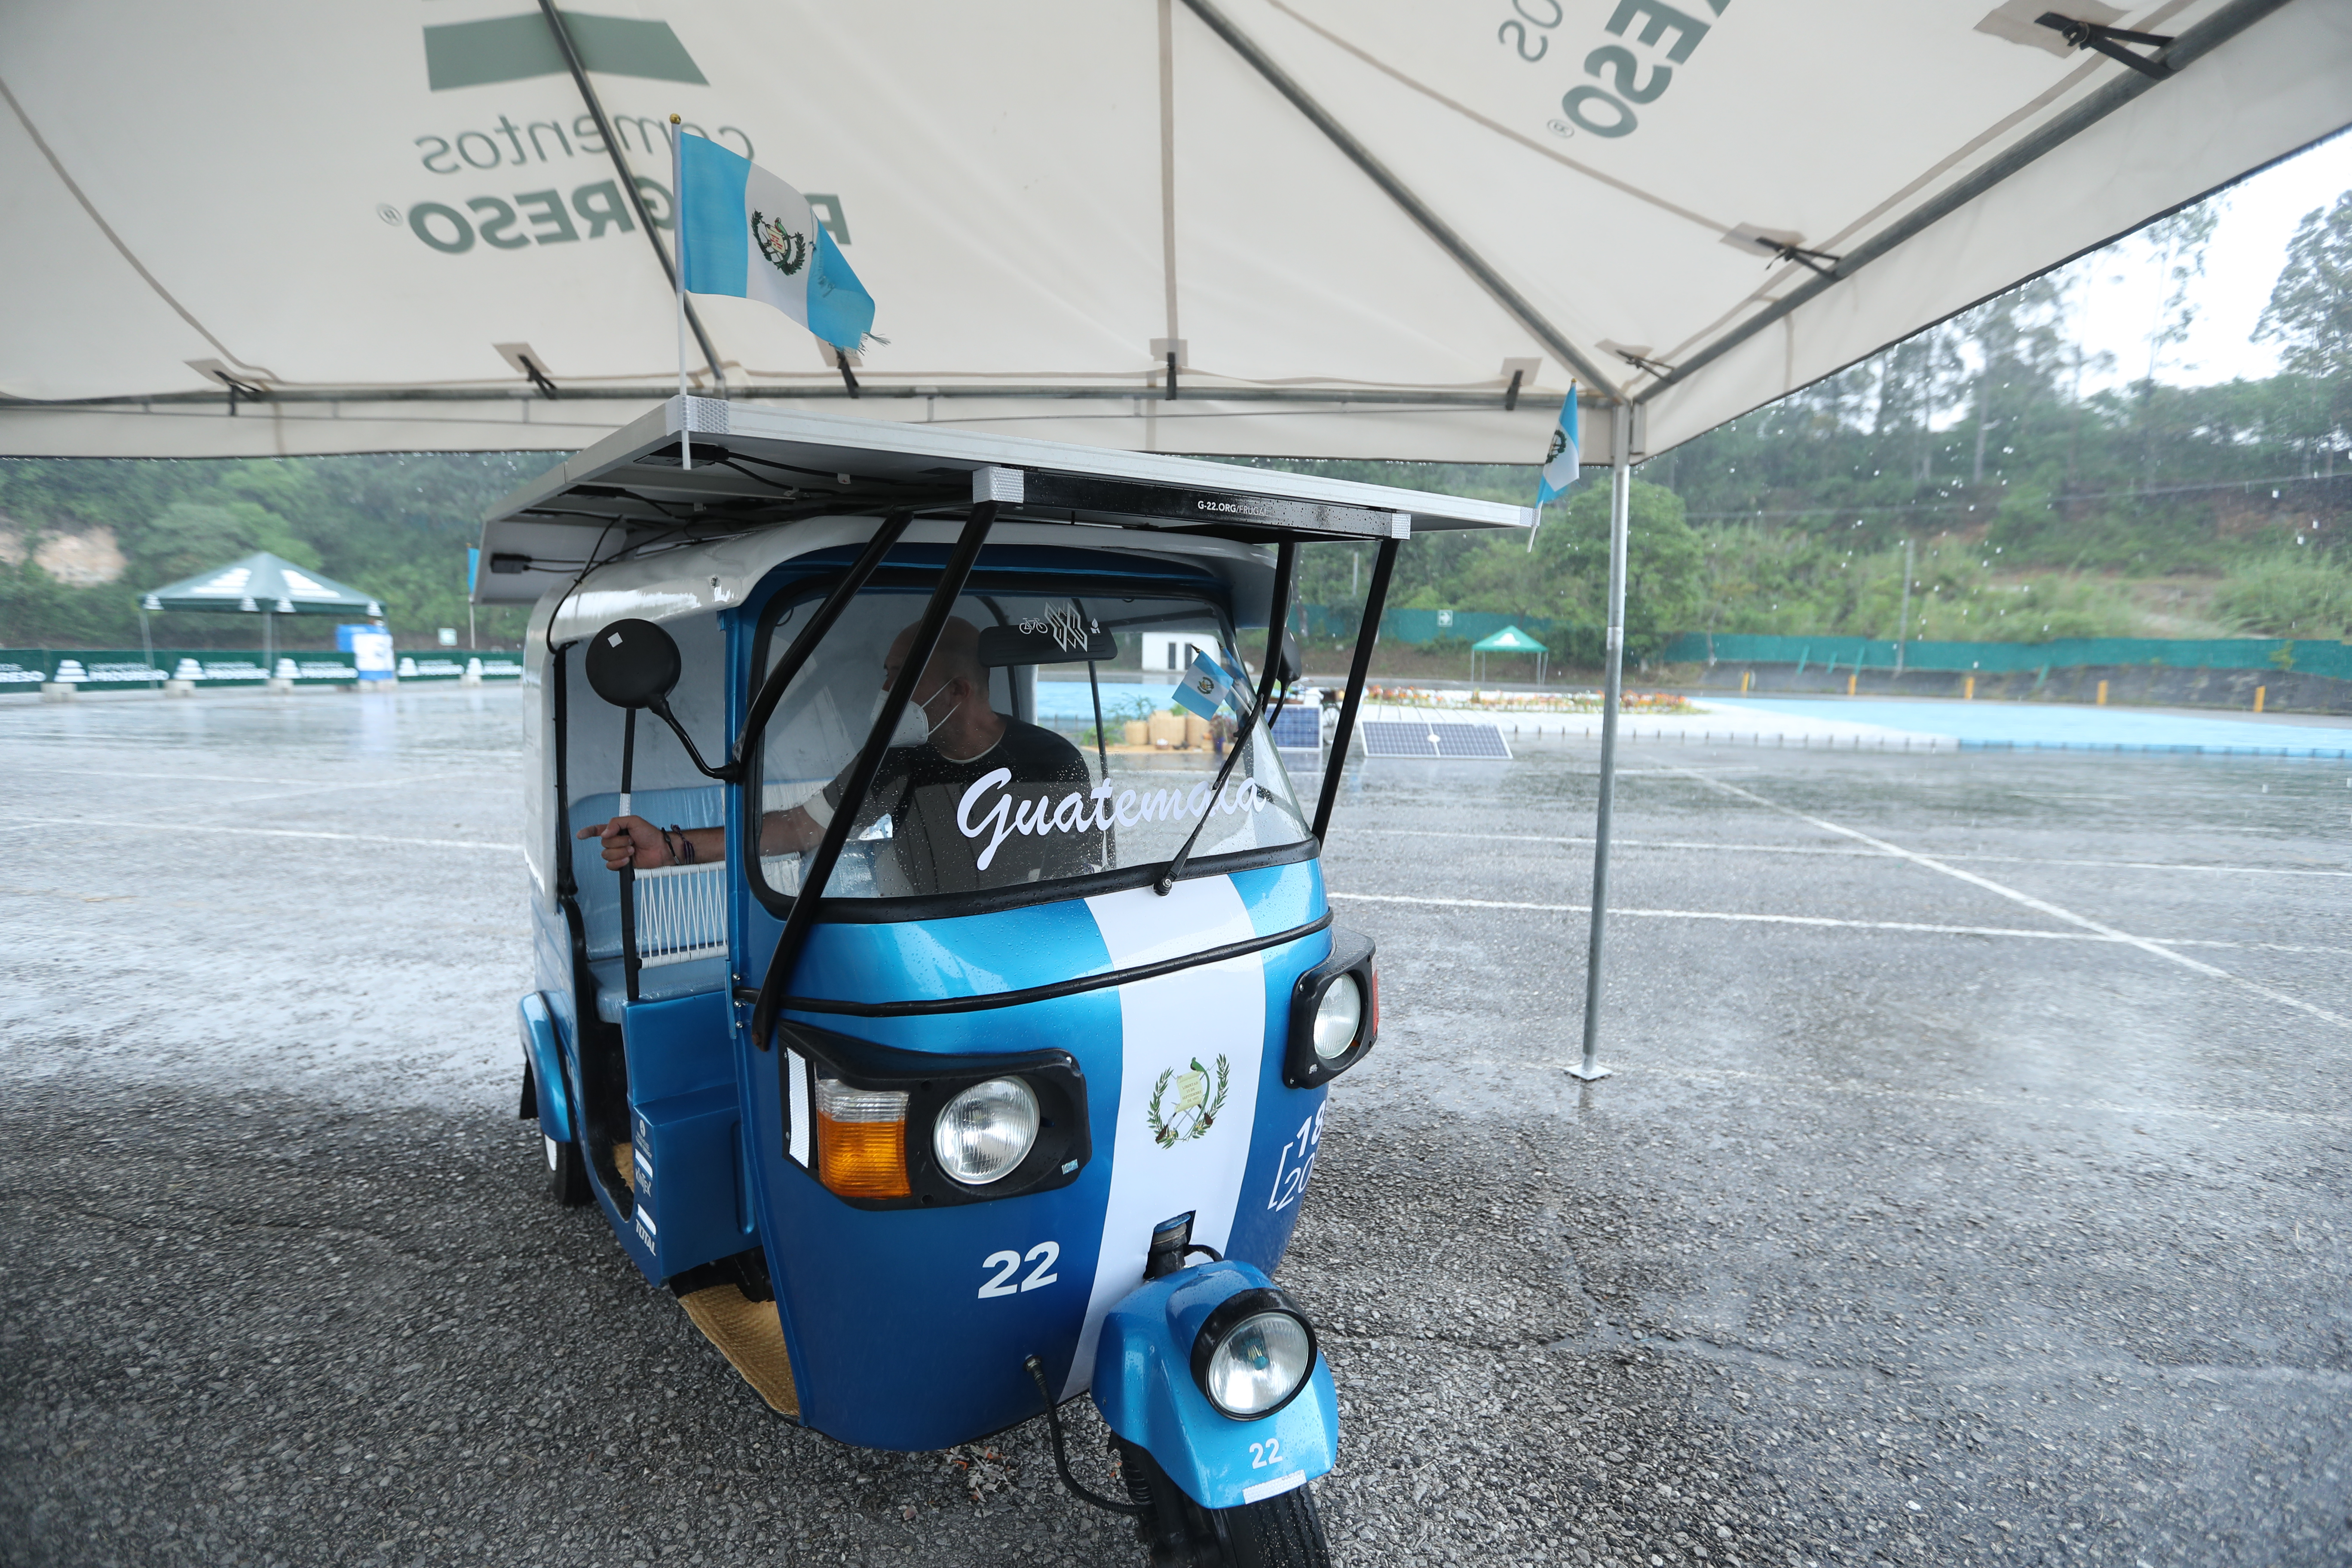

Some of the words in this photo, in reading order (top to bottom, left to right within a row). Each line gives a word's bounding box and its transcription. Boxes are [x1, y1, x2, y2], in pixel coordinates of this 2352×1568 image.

[1197, 500, 1268, 516] G-22.ORG/FRUGAL
[956, 767, 1267, 870] Guatemala
[636, 1219, 656, 1256] TOTAL
[977, 1241, 1060, 1299] 22
[1249, 1438, 1283, 1469] 22
